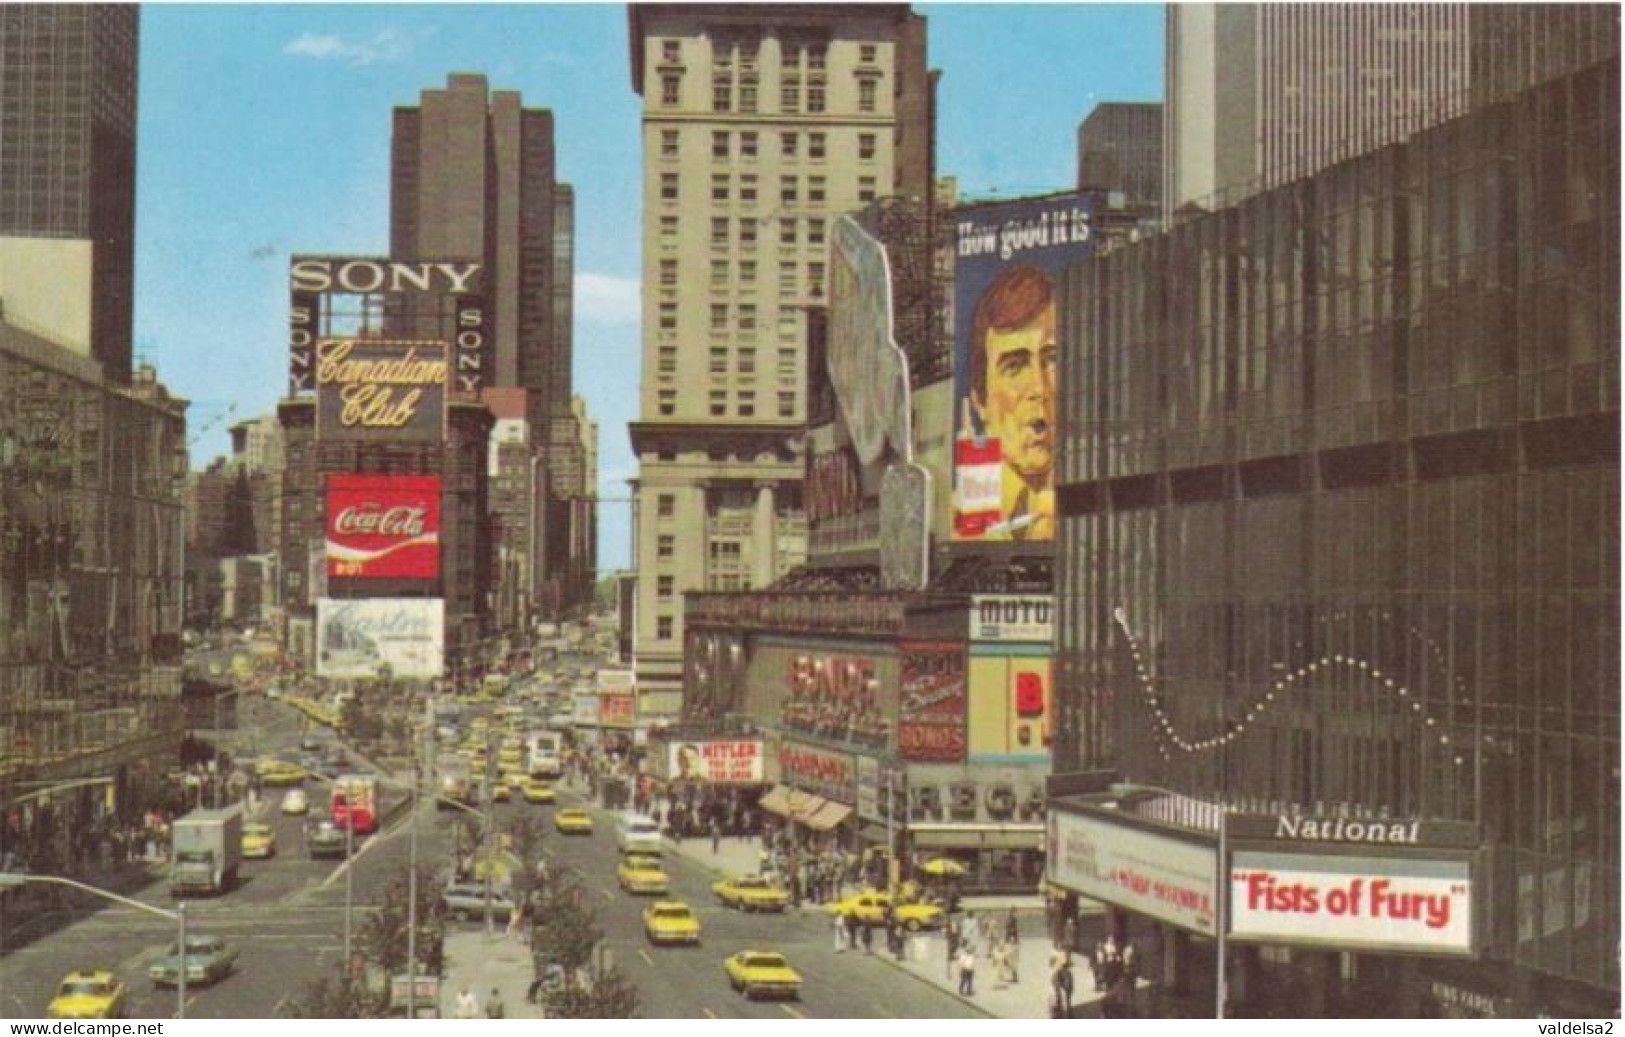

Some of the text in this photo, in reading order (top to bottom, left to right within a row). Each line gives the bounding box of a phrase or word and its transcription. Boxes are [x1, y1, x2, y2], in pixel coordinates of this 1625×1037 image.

[1001, 212, 1048, 260] good
[291, 260, 480, 292] SONY
[290, 306, 311, 388] SONY
[318, 341, 448, 384] Canadian
[457, 309, 482, 392] SONY
[341, 385, 423, 427] Club
[334, 505, 427, 536] Coca-Cola
[702, 743, 757, 758] HITLER
[1275, 815, 1422, 843] National
[1326, 879, 1363, 916] of
